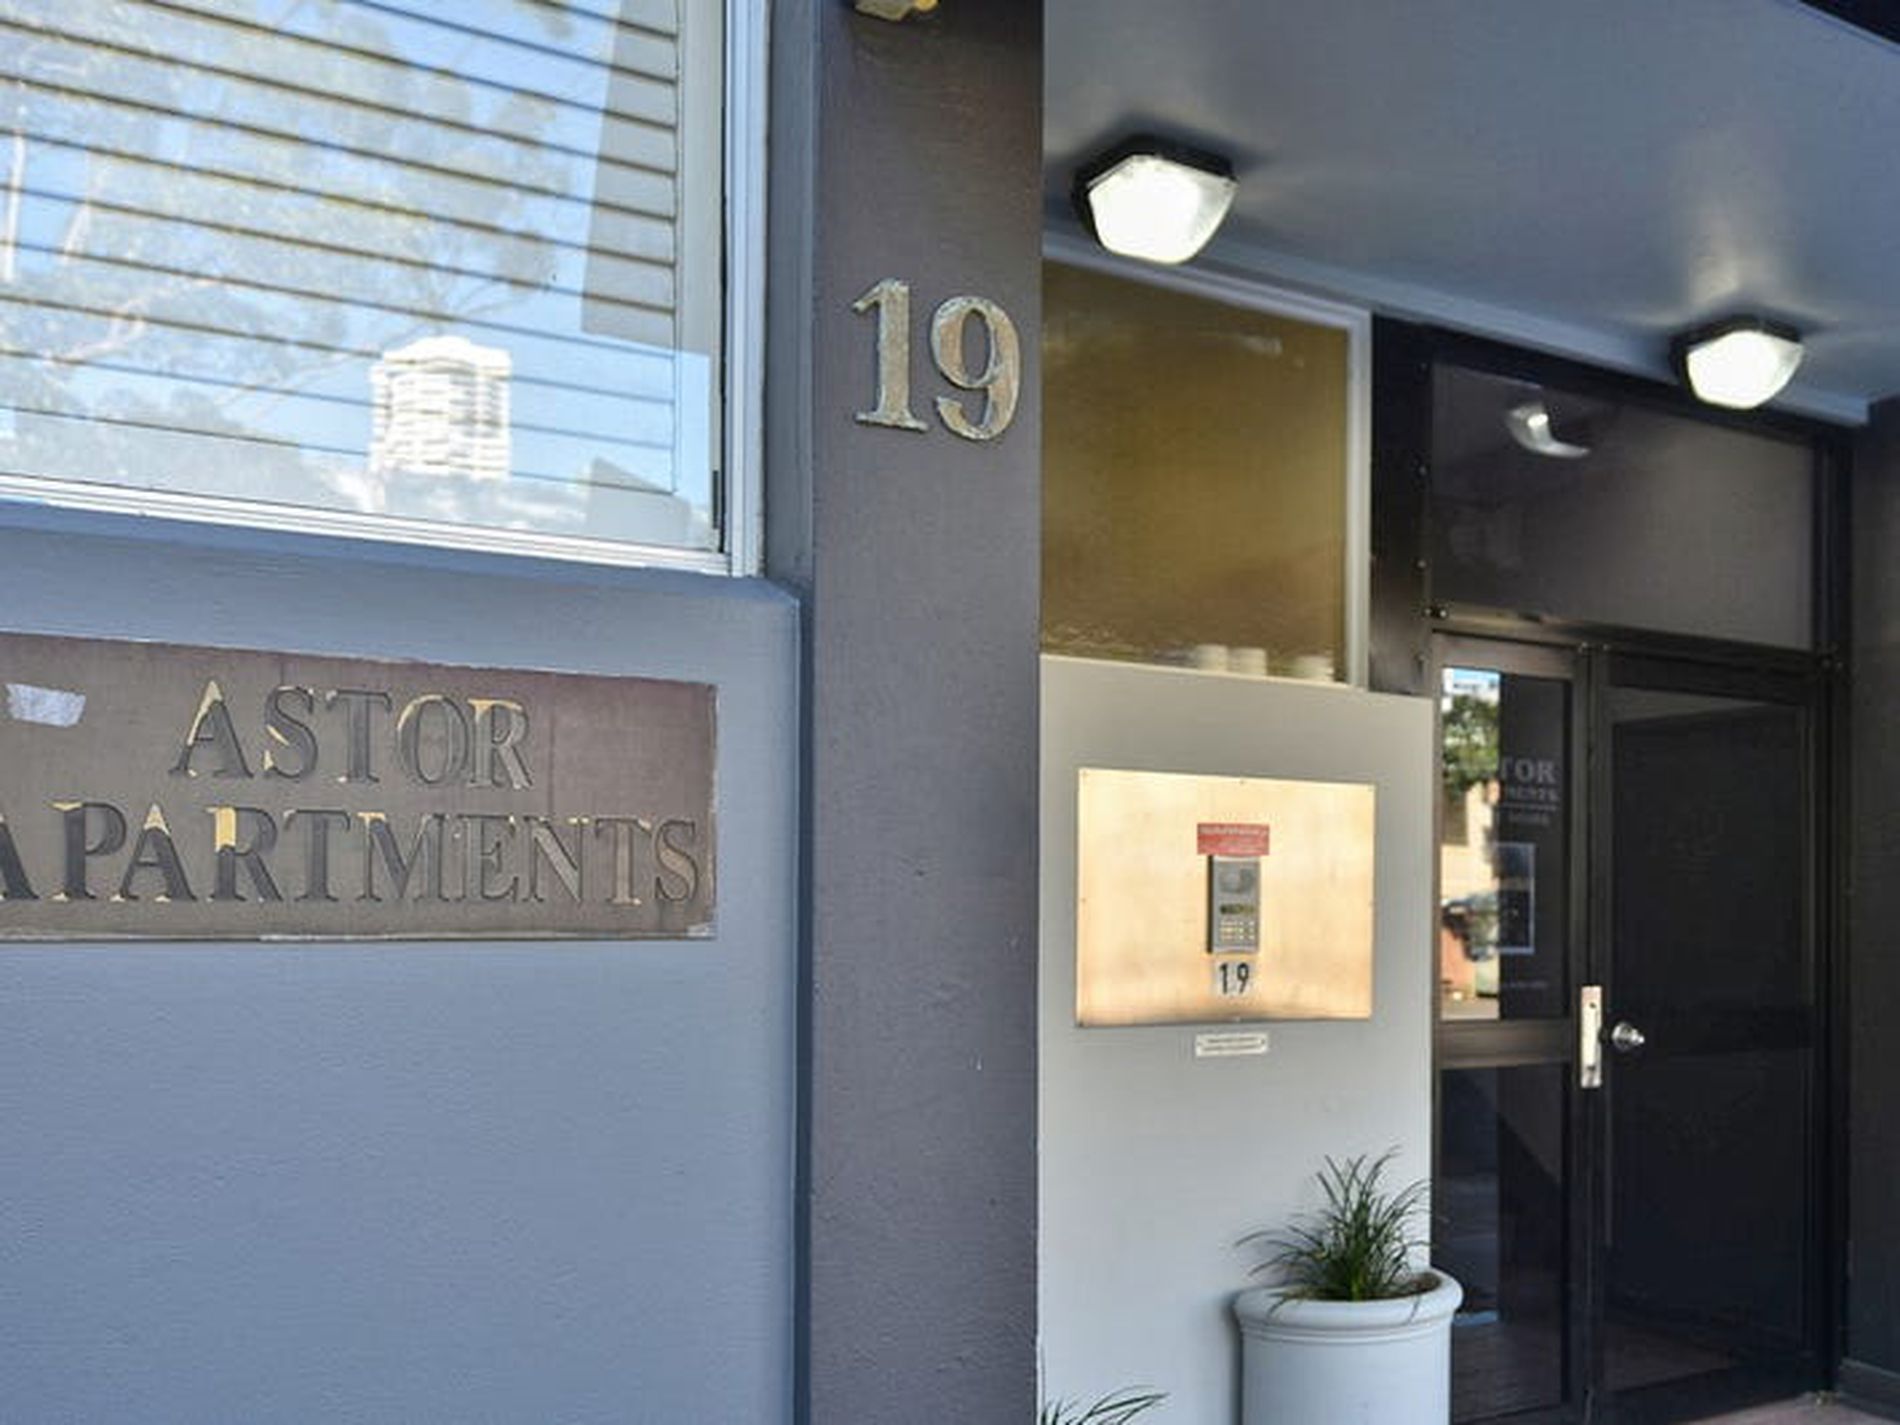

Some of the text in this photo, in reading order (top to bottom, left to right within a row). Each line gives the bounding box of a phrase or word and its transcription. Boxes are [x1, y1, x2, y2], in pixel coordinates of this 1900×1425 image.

[853, 278, 1020, 440] 19
[168, 680, 533, 789] ASTOR
[1219, 962, 1249, 994] 19
